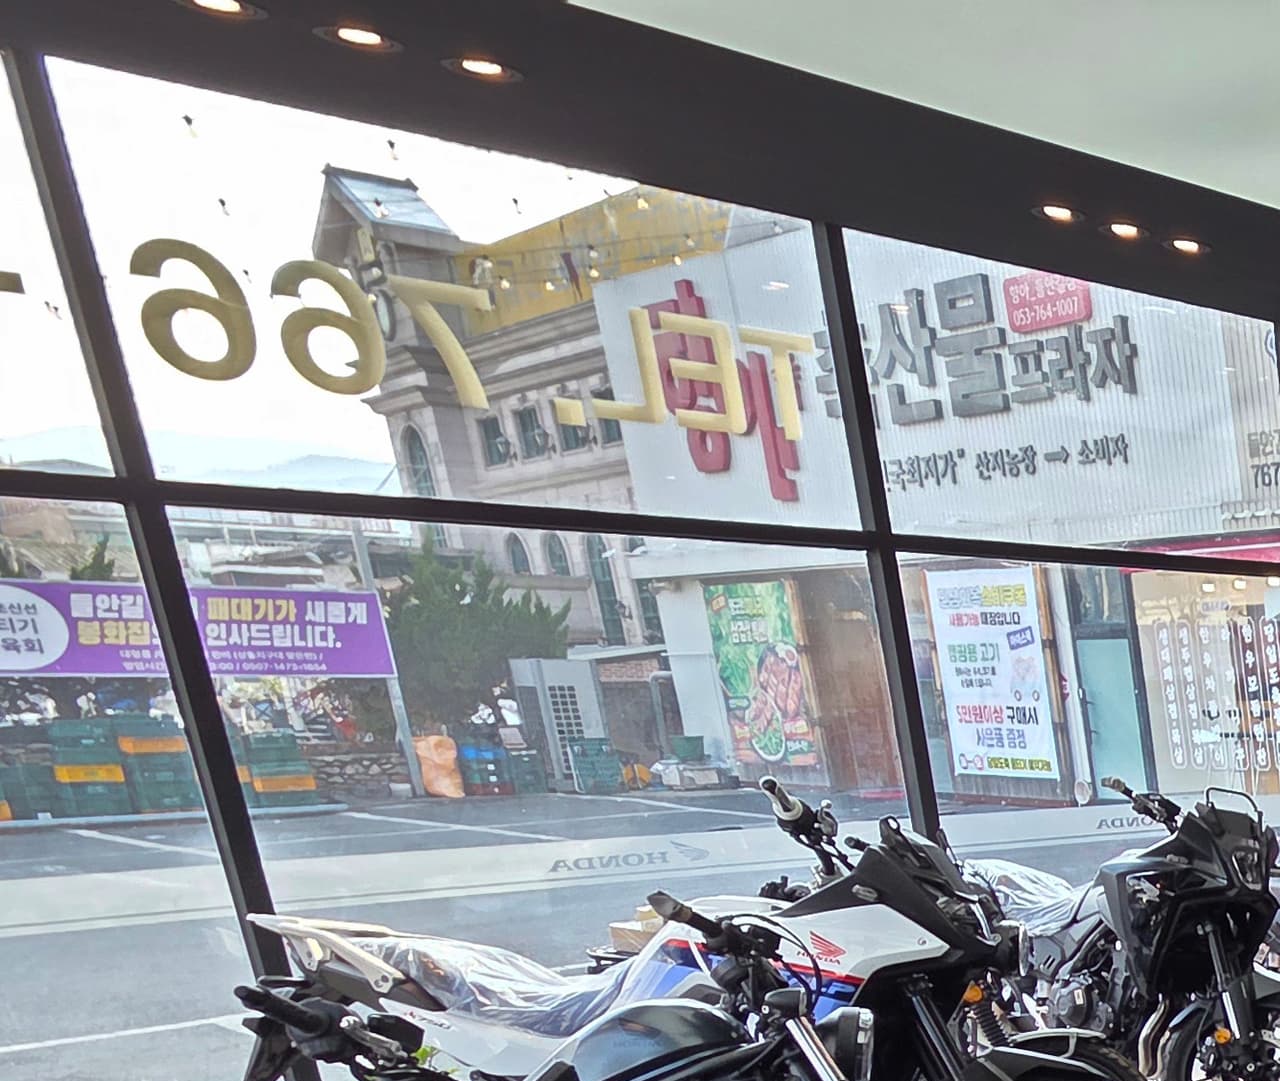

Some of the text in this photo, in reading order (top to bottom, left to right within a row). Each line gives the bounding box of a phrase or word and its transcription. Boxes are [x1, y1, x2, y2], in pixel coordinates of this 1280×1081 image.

[1012, 296, 1079, 327] 053-764-1007
[1077, 433, 1129, 466] 소비자
[305, 600, 368, 624] 새롭게
[205, 623, 342, 648] 인사드립니다.
[979, 642, 1001, 664] 고기
[1005, 705, 1040, 726] 구매시
